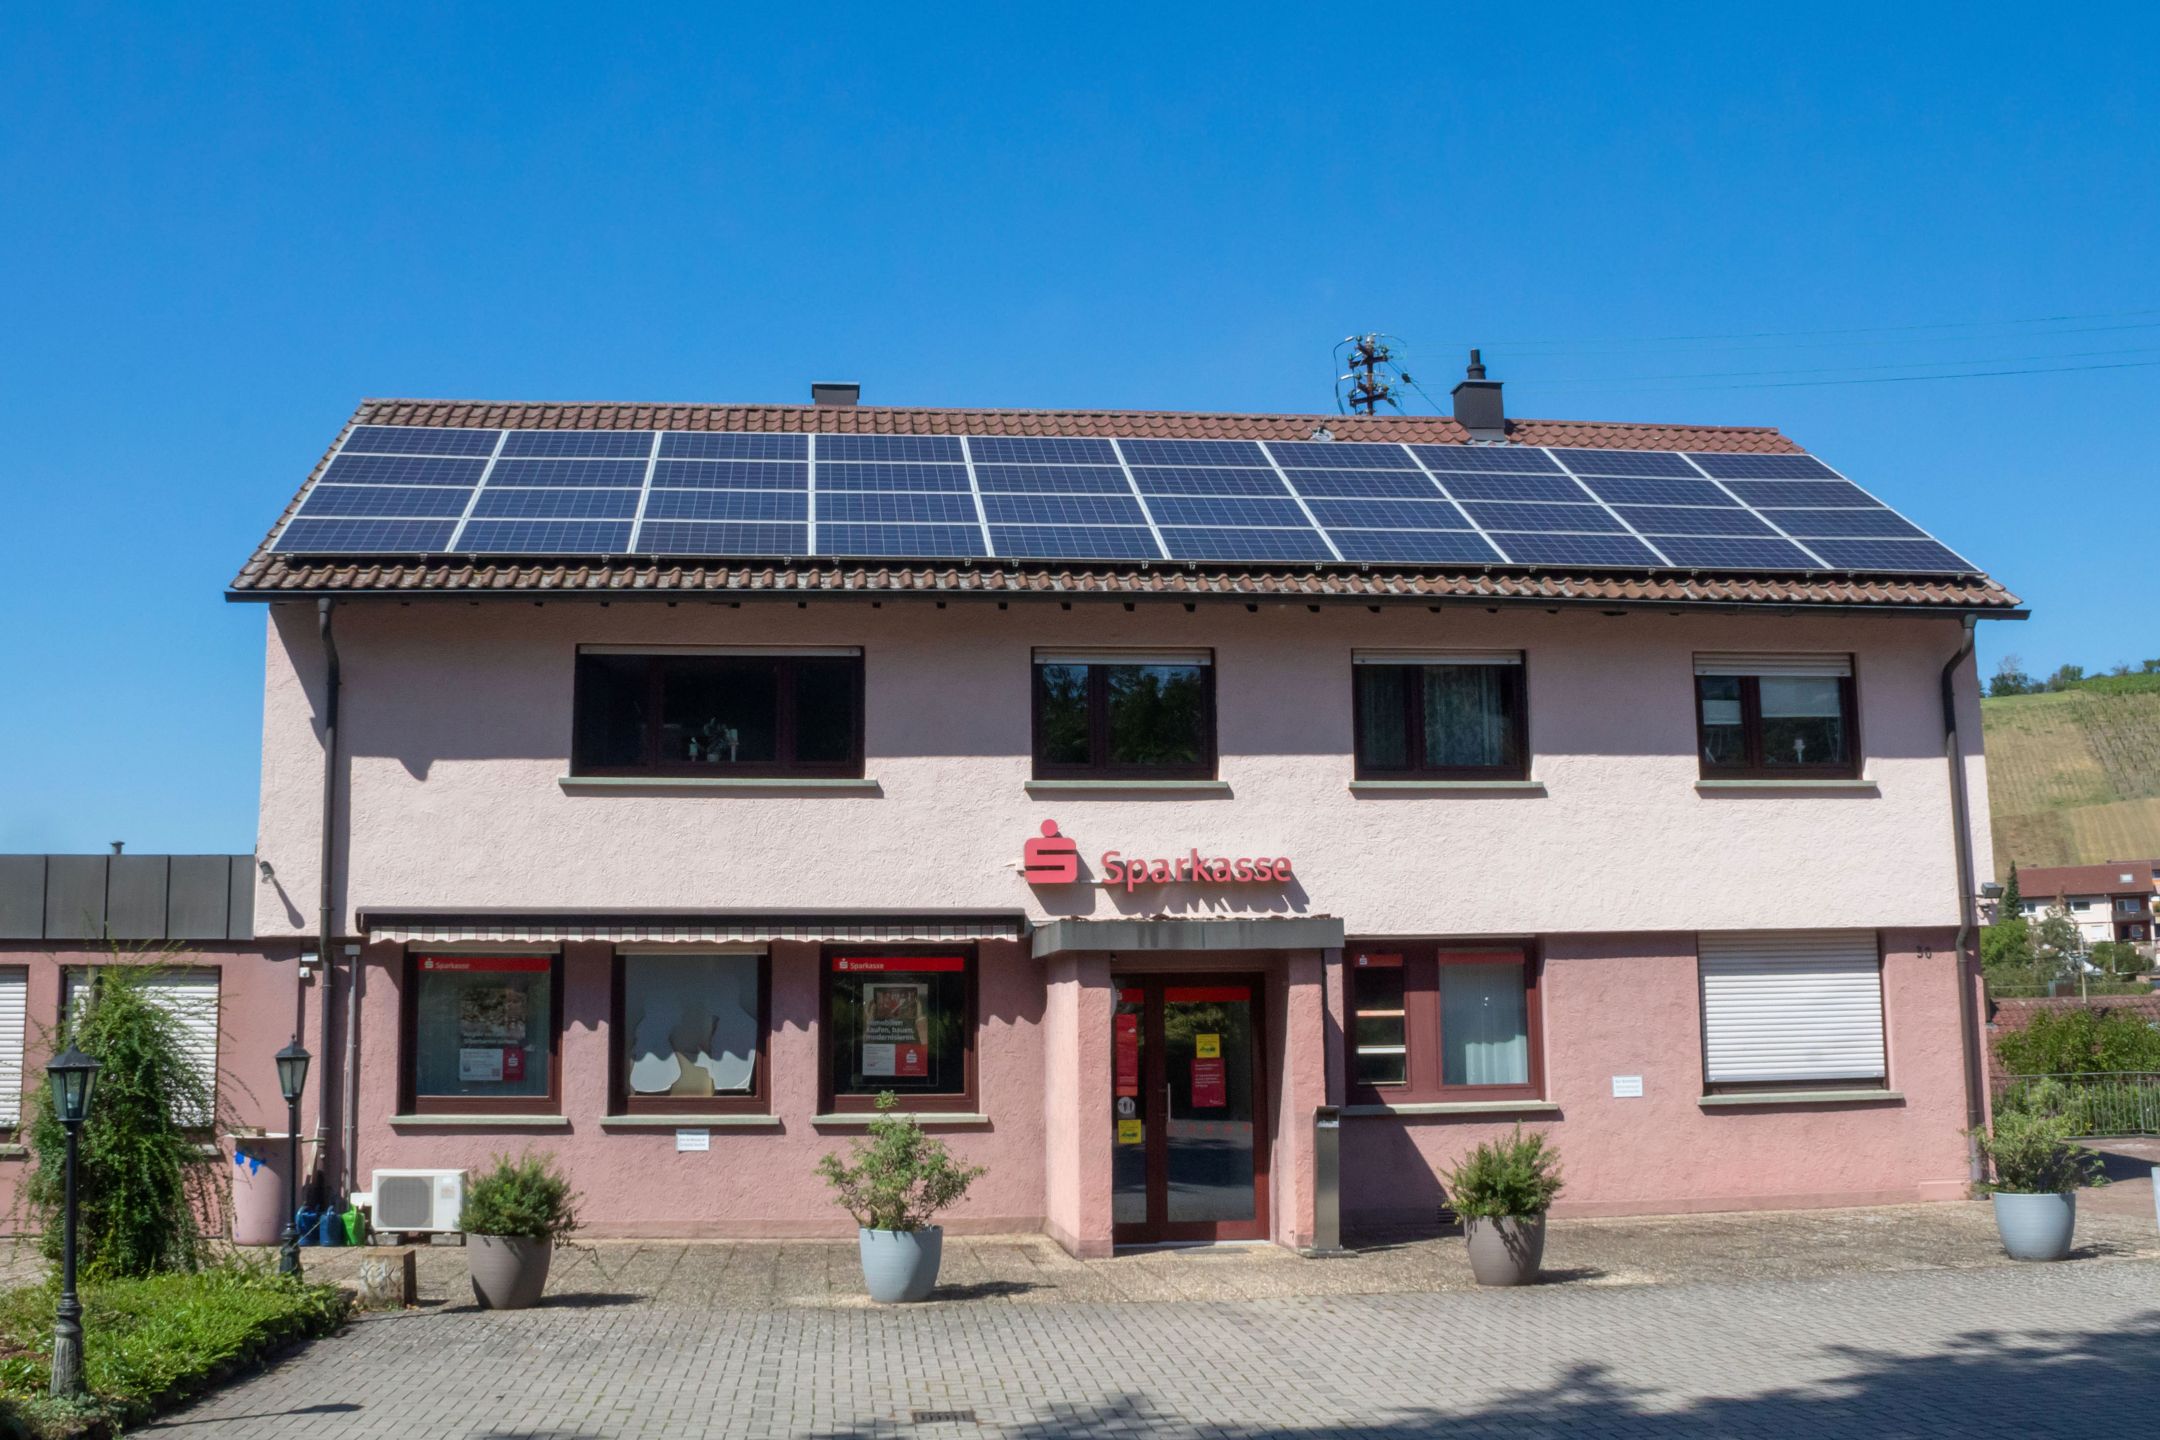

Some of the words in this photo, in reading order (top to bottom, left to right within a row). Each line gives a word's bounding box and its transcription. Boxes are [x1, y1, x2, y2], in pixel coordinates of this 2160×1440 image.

[1101, 848, 1292, 892] Sparkasse
[435, 961, 470, 970] Sparkasse
[850, 962, 885, 970] Sparkasse
